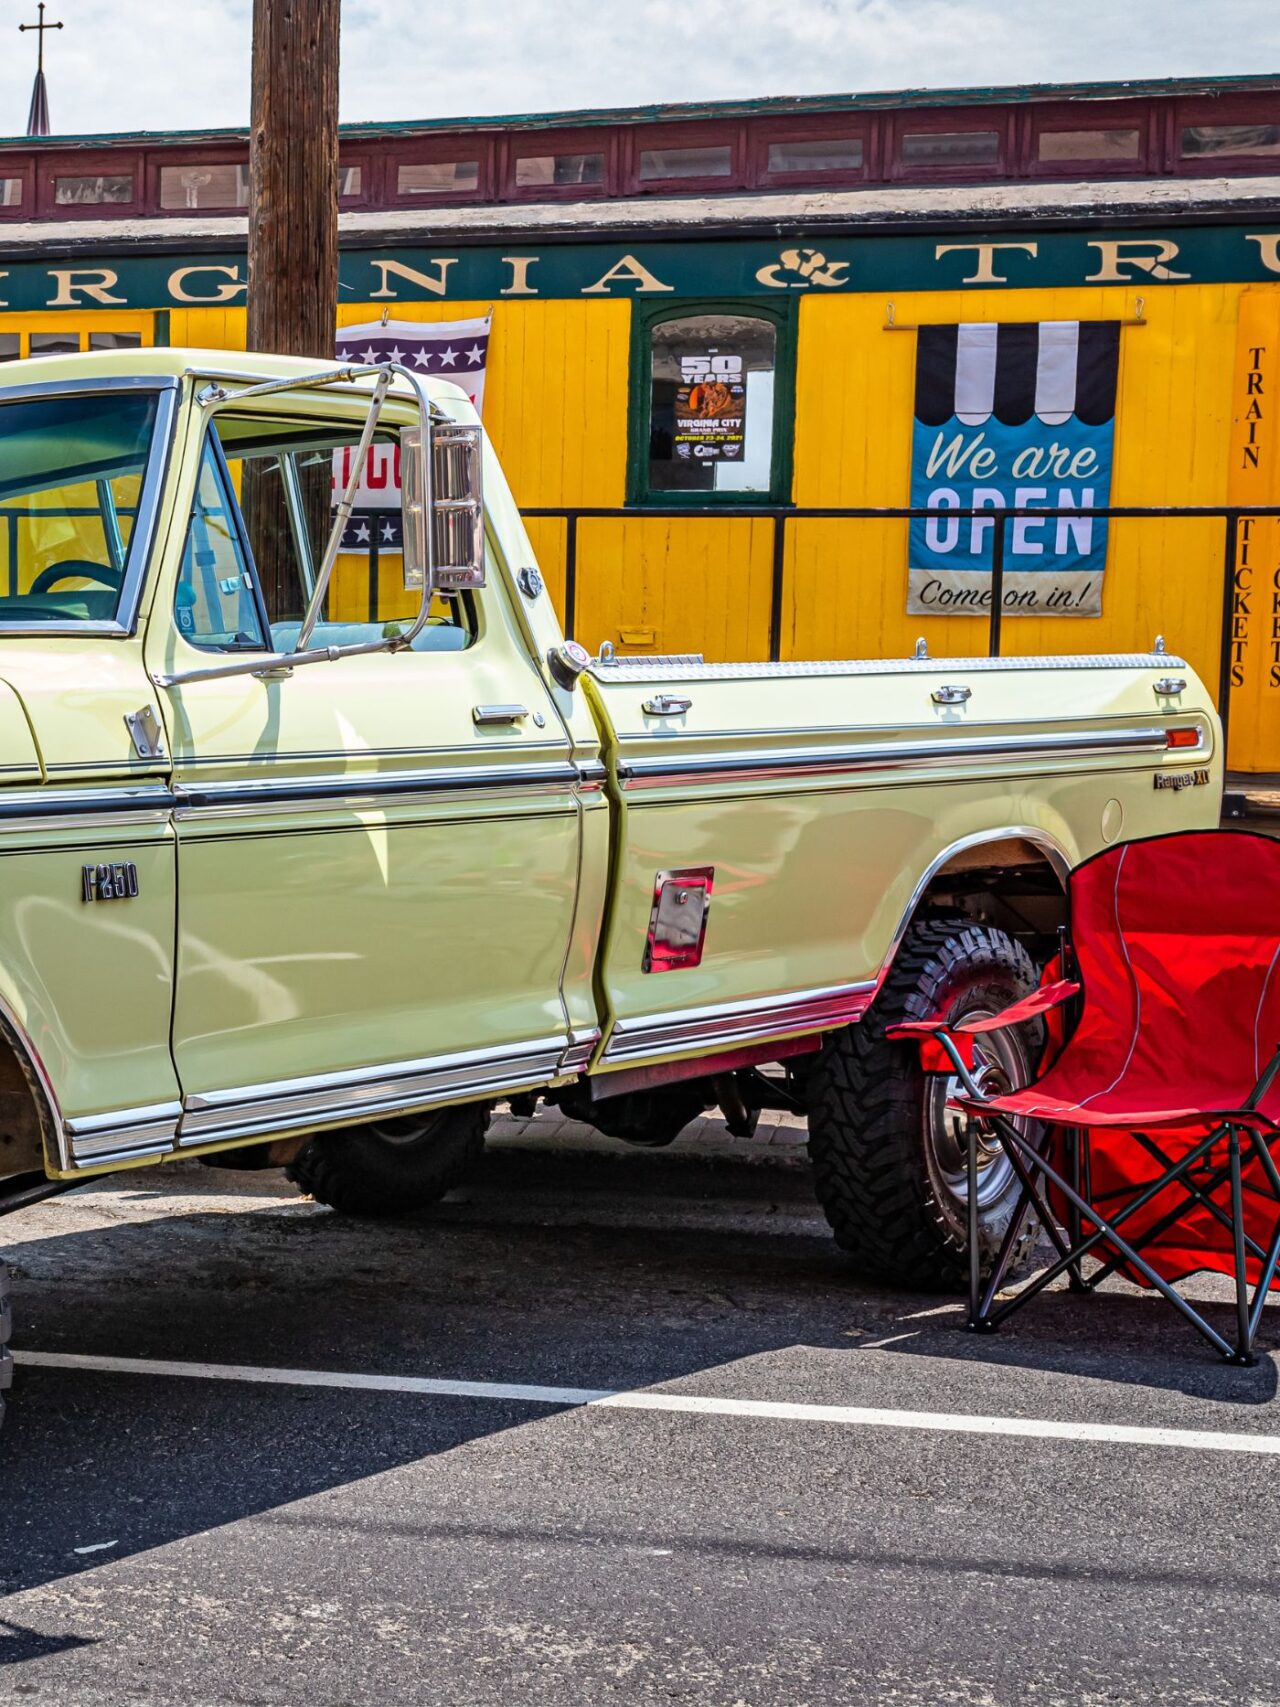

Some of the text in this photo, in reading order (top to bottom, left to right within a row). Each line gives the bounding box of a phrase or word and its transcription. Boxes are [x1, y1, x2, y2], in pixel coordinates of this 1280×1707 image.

[681, 356, 742, 374] 50
[681, 373, 742, 383] YEARS
[677, 419, 741, 427] VIRGINIA CITY
[1241, 347, 1266, 468] TRAIN
[926, 432, 1099, 479] We are
[925, 487, 1095, 555] OPEN
[920, 580, 1091, 607] Come on in!
[1231, 519, 1255, 688] TICKETS
[81, 861, 139, 903] F250
